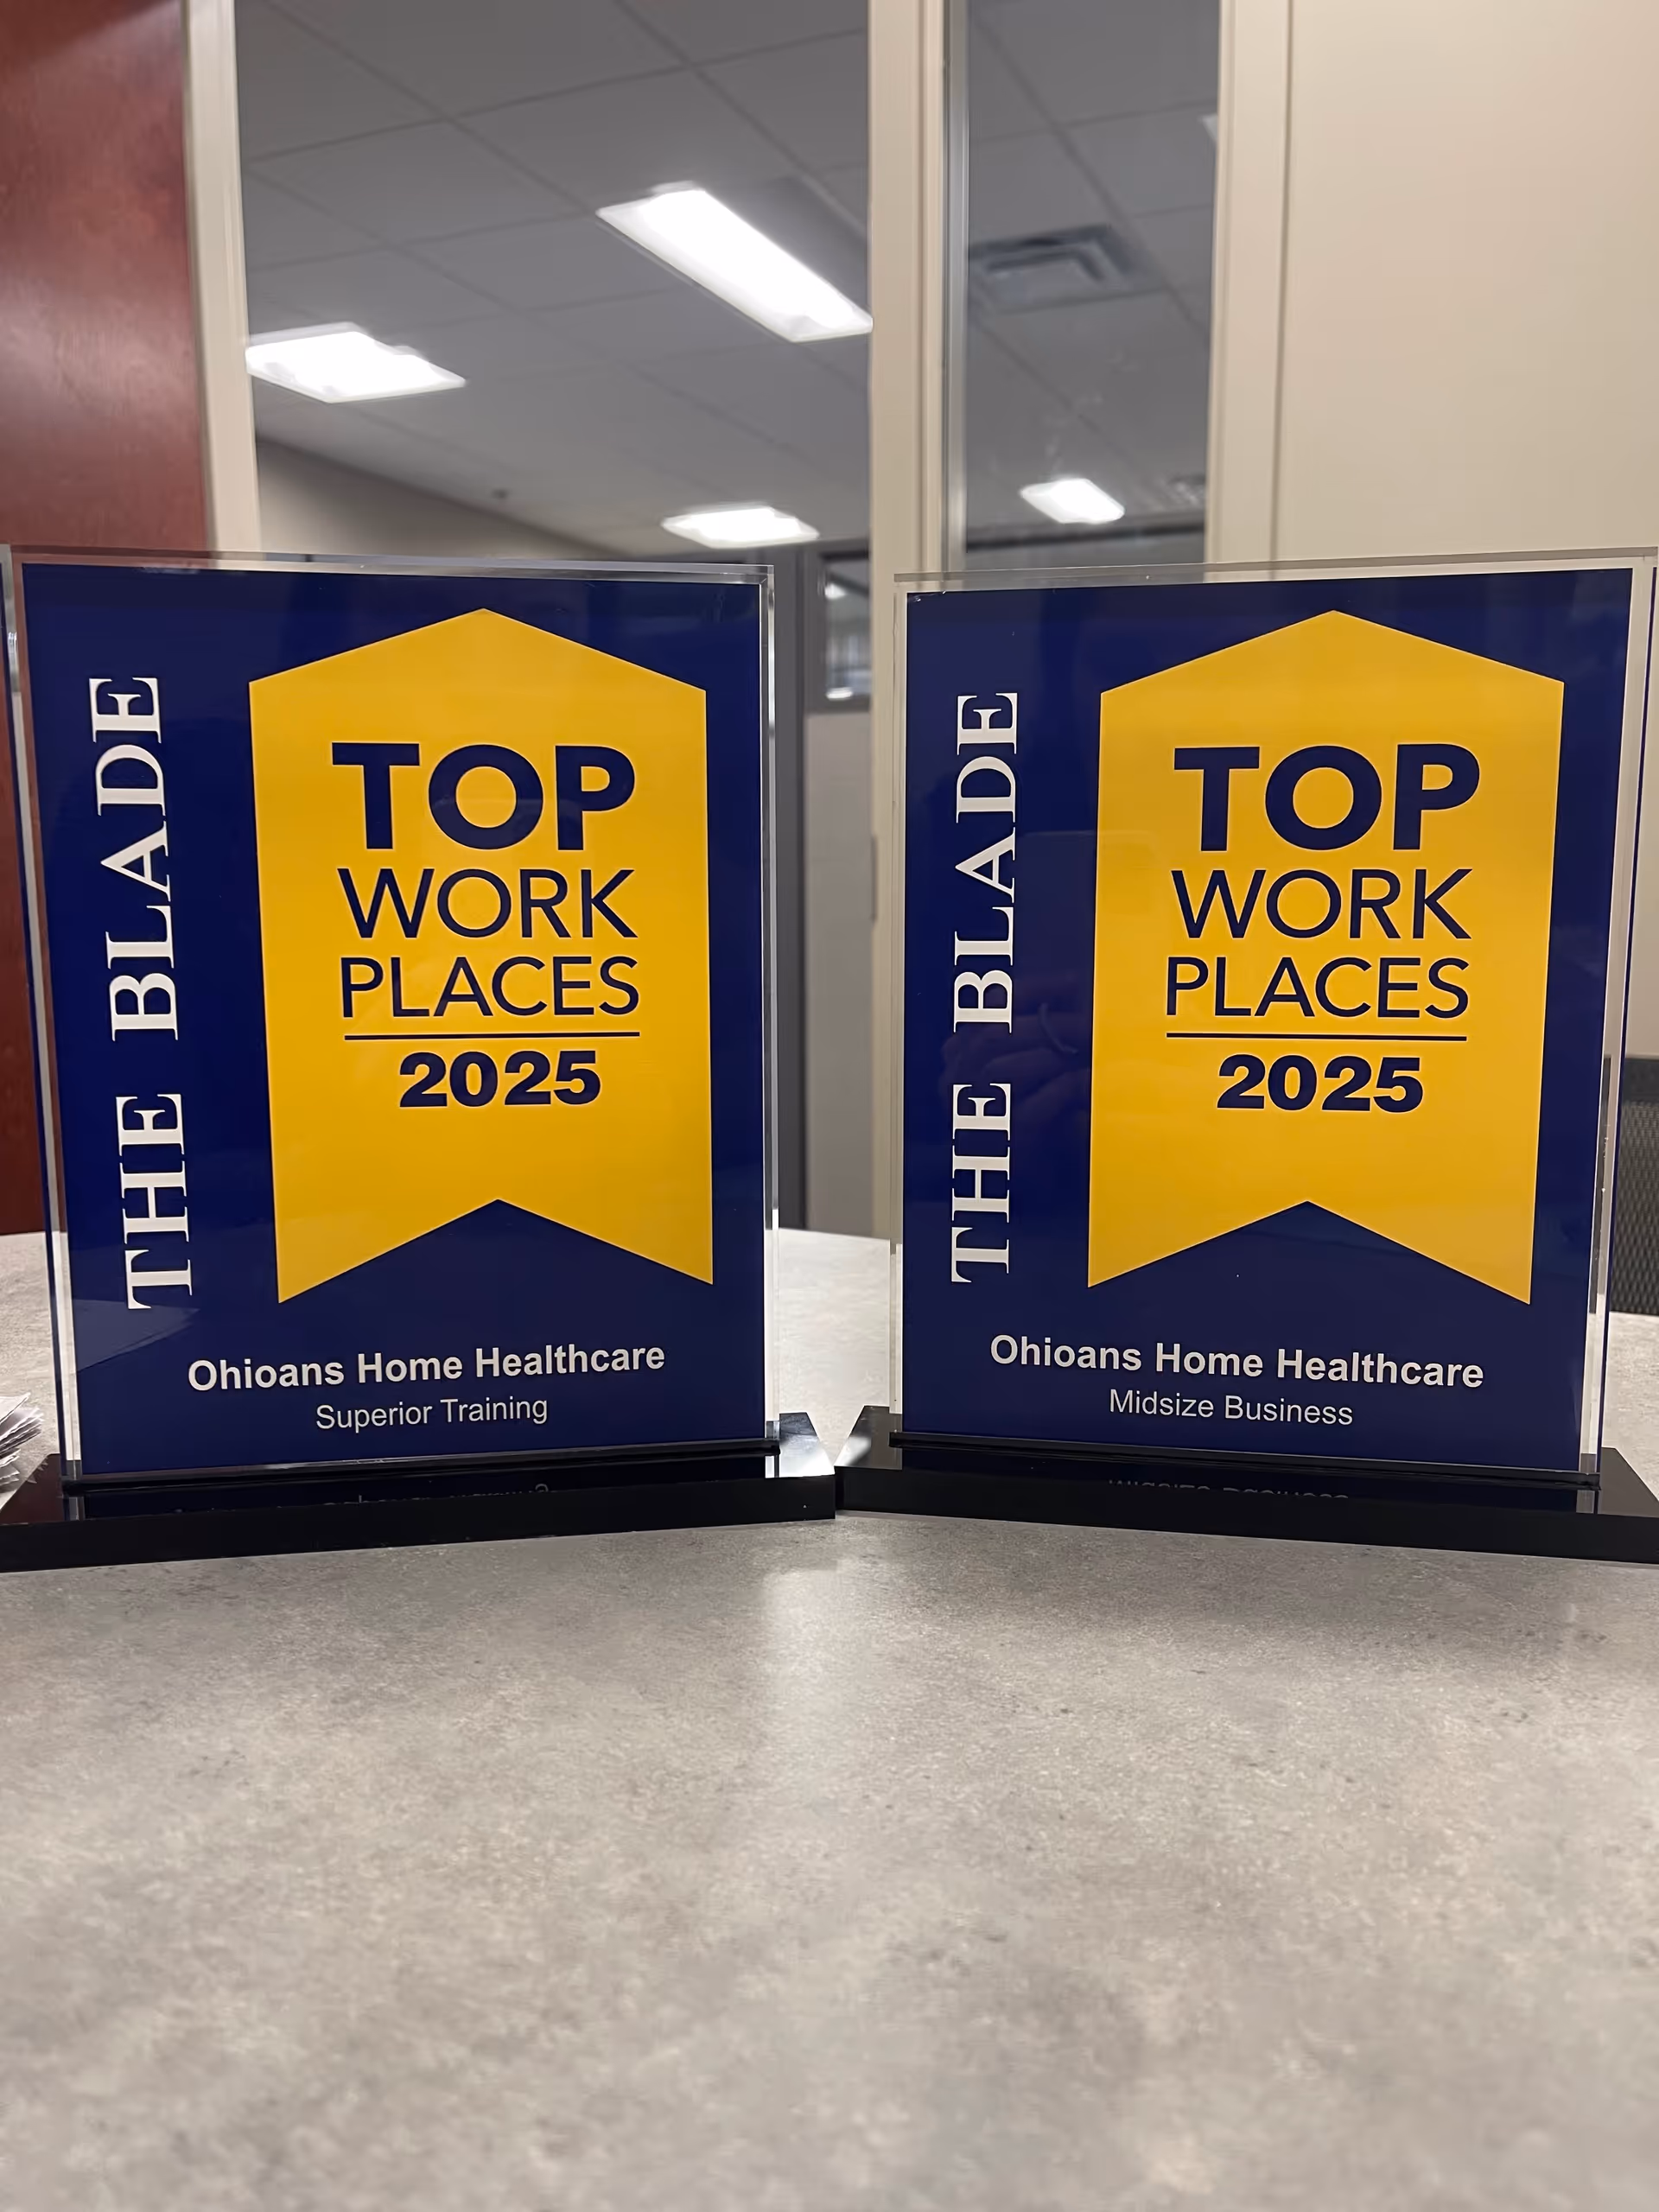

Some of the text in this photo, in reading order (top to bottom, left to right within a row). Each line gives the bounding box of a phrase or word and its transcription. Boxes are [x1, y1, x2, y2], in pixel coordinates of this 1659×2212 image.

[331, 741, 635, 851] TOP
[1173, 743, 1480, 852] TOP
[337, 868, 639, 938] WORK
[1171, 868, 1473, 939] WORK
[88, 677, 193, 1310] THE BLADE
[340, 956, 639, 1018] PLACES
[950, 692, 1018, 1283] THE BLADE
[1166, 957, 1470, 1019] PLACES
[399, 1050, 601, 1108] 2025
[1217, 1053, 1423, 1113] 2025
[188, 1344, 665, 1391] Ohioans Home Healthcare
[990, 1334, 1484, 1388] Ohioans Home Healthcare
[316, 1398, 547, 1433] Superior Training
[1110, 1389, 1353, 1426] Midsize Business
